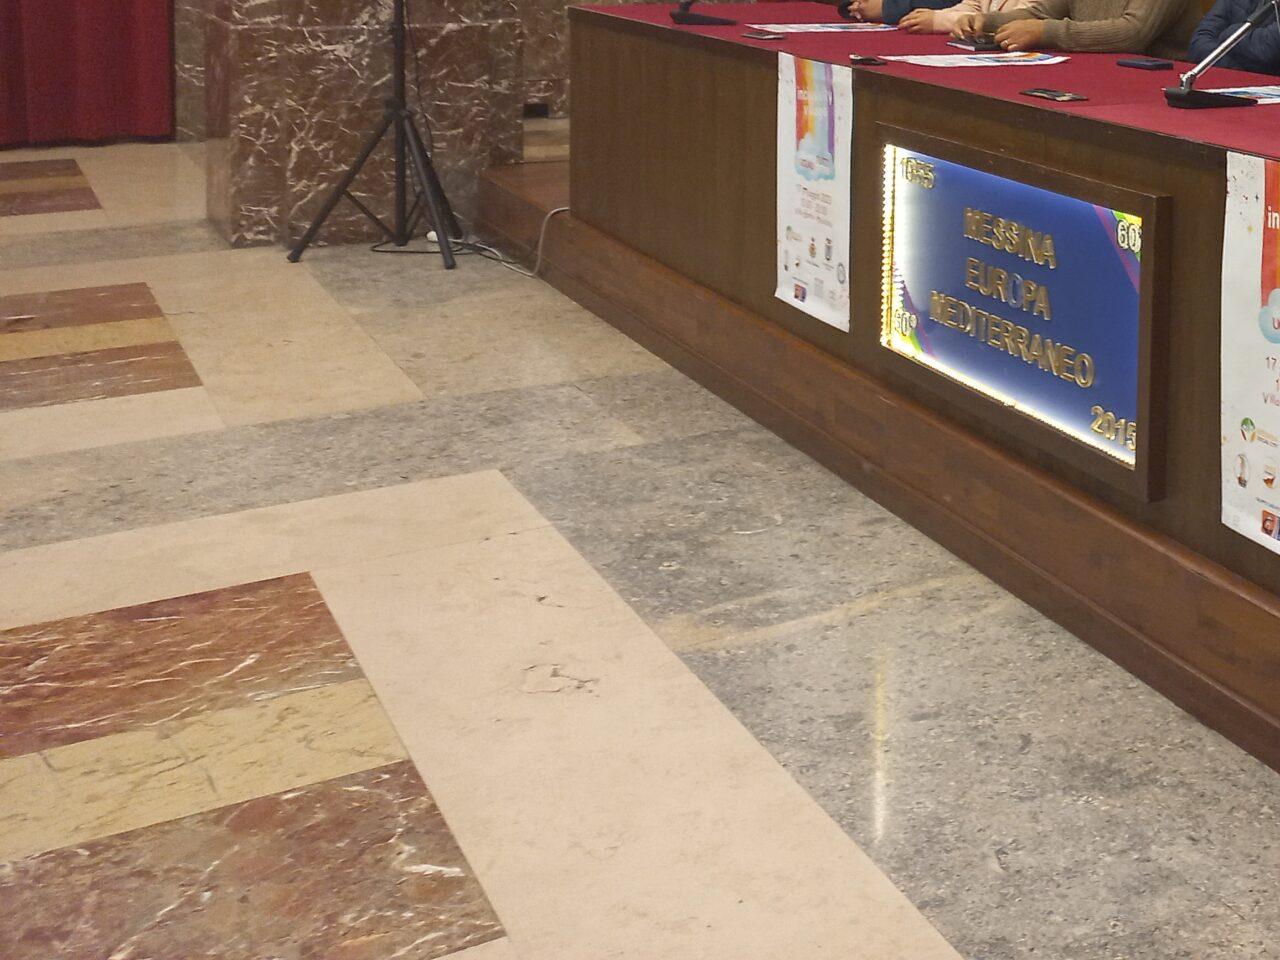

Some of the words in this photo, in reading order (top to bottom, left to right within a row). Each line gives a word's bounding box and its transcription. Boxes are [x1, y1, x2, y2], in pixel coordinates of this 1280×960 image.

[963, 206, 1057, 270] MESSINA
[965, 257, 1052, 321] EUROPA
[929, 290, 1095, 388] MEDITERRANEO
[1265, 355, 1277, 371] 17
[1090, 405, 1136, 451] 2015
